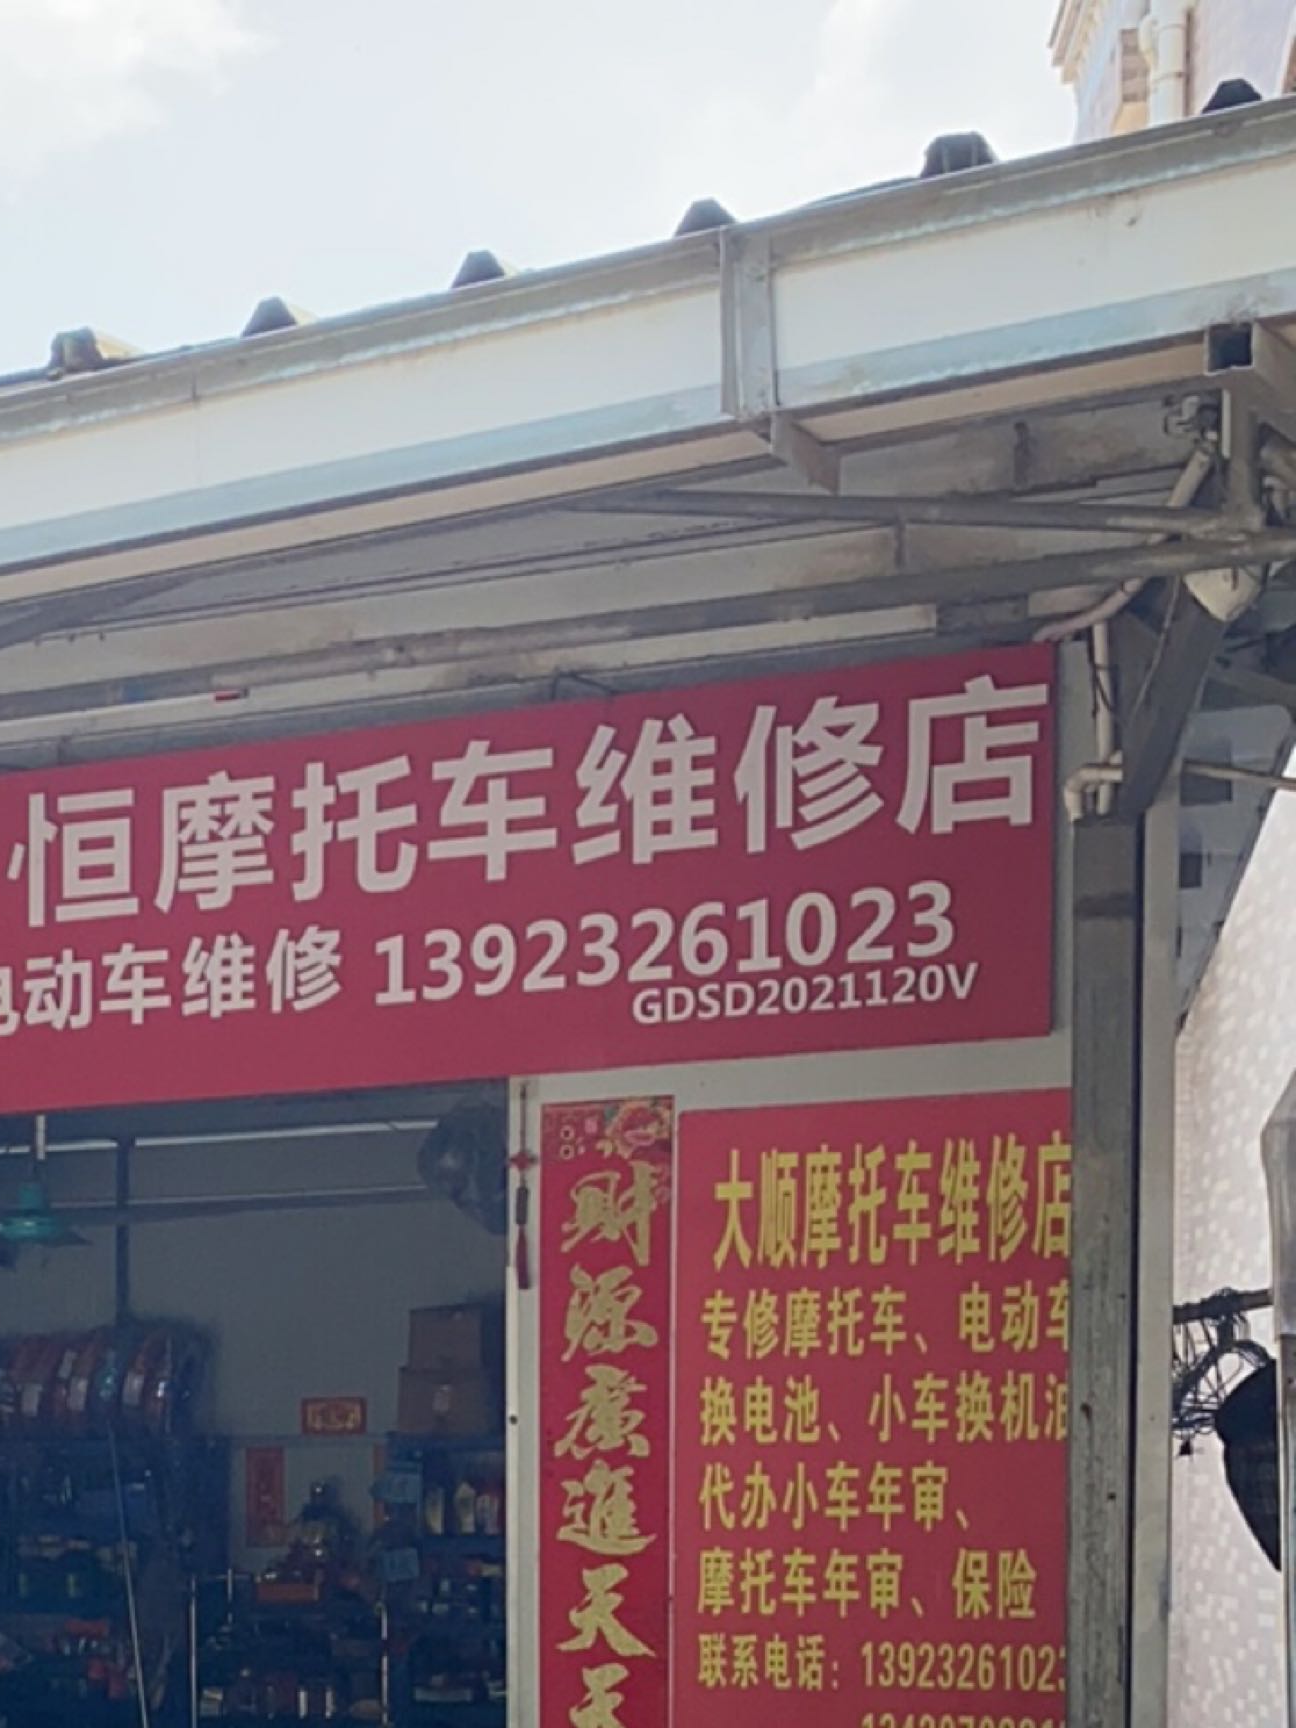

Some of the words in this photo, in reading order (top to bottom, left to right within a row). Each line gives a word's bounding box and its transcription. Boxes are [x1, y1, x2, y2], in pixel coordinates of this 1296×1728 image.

[374, 880, 954, 1006] 13923261023
[632, 962, 977, 1025] GDSD2021120V
[713, 1130, 1072, 1273] 大顺摩托车维修店
